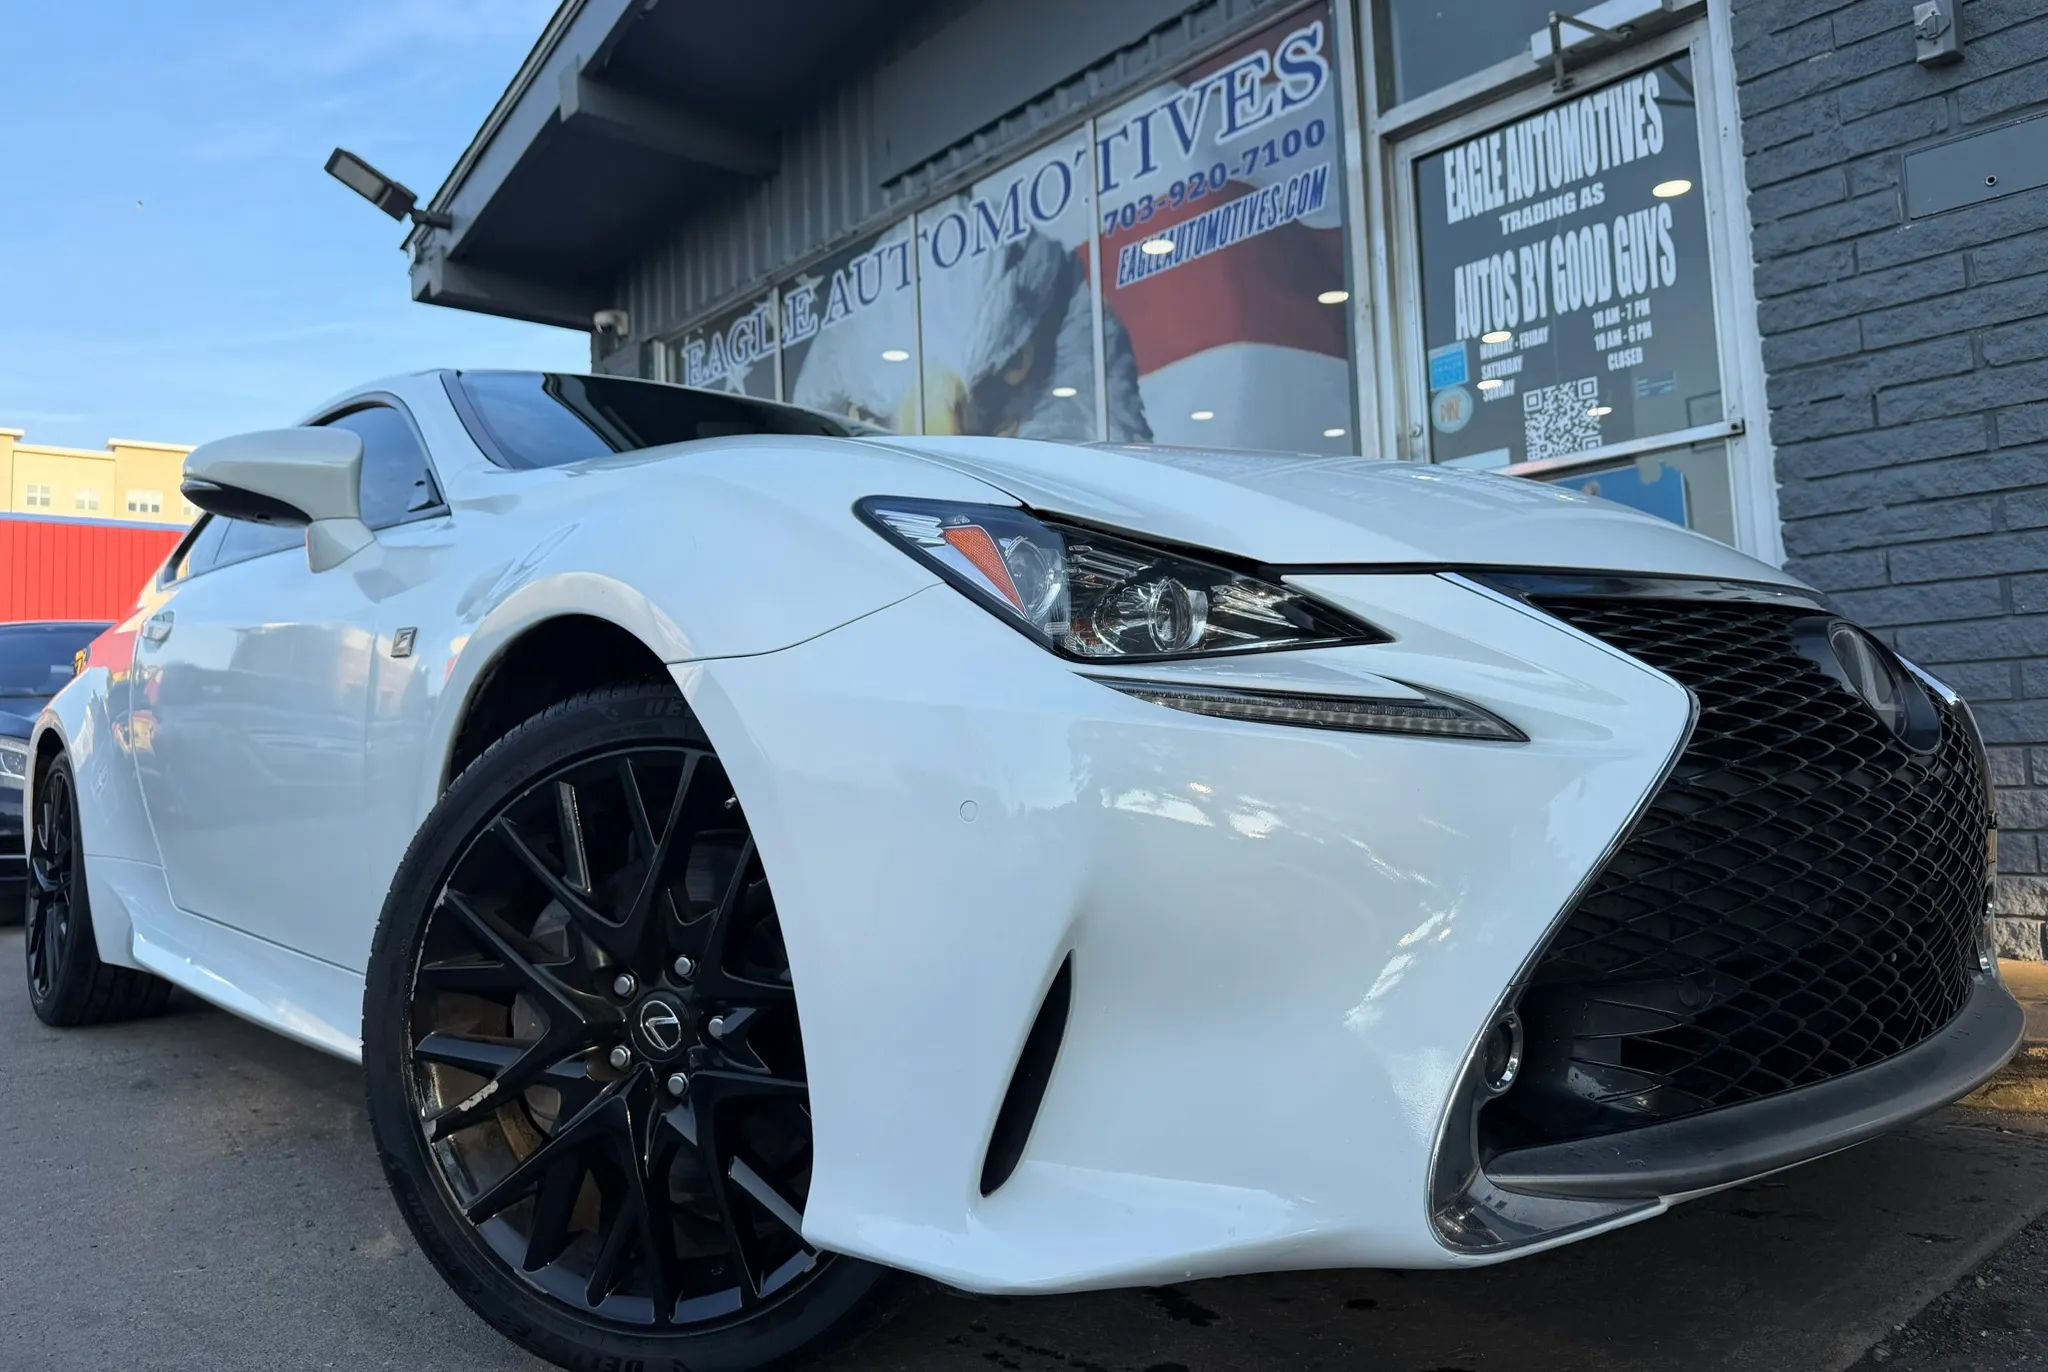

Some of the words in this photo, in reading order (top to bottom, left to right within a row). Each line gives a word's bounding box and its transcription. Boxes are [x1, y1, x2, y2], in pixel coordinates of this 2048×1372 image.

[685, 287, 818, 386] EAGLE
[823, 19, 1329, 329] AUTOMOTIVES
[1102, 117, 1328, 238] 703-920-7100
[1444, 131, 1504, 224] EAGLE
[1505, 71, 1664, 204] AUTOMOTIVES
[1499, 188, 1576, 235] TRADING
[1576, 181, 1606, 212] AS
[1117, 163, 1329, 288] EAGLEAUTOMOTIVES.COM
[1453, 249, 1518, 341] AUTOS
[1518, 239, 1548, 323] BY
[1550, 218, 1612, 315] GOOD
[1613, 202, 1677, 298] GUYS
[1481, 354, 1523, 380] SATURDAY
[1519, 326, 1549, 351] FRIDAY
[1607, 346, 1643, 372] CLOSED
